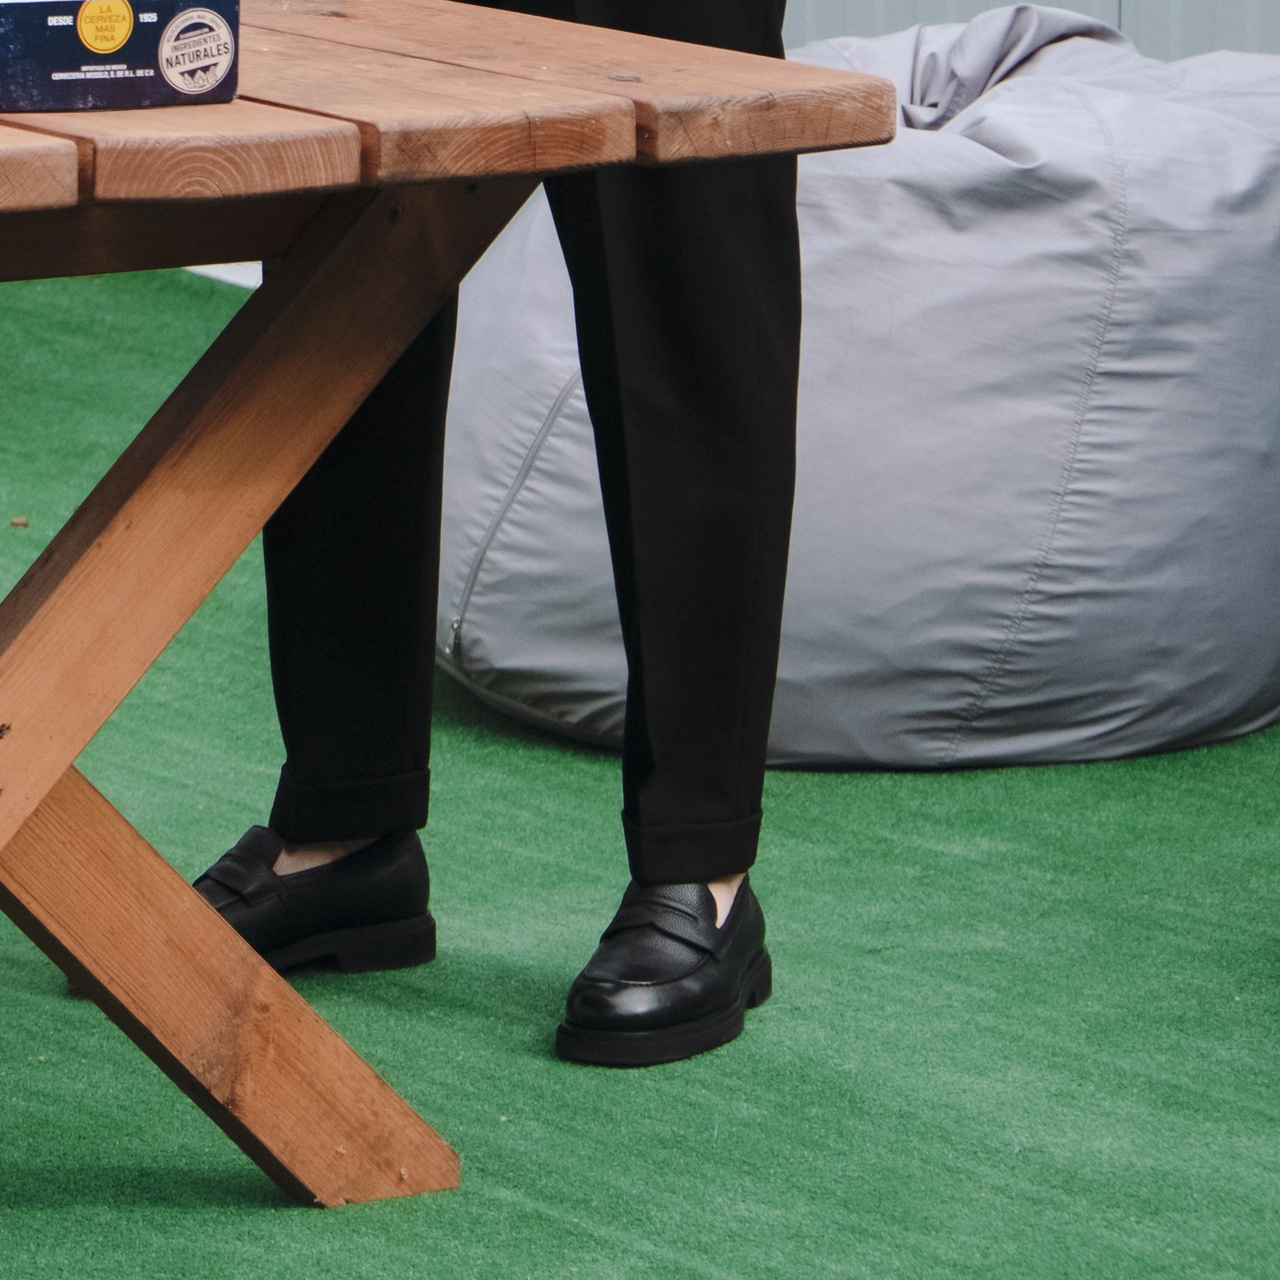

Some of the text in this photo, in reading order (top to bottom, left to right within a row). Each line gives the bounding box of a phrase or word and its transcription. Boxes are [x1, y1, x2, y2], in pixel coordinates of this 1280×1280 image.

[99, 5, 112, 14] LA
[47, 15, 74, 27] DESDE
[84, 14, 128, 24] CERVEZA
[95, 25, 116, 33] MAS
[94, 34, 116, 43] FINA
[171, 33, 221, 53] INGREDIENTES
[165, 42, 230, 69] NATURALES
